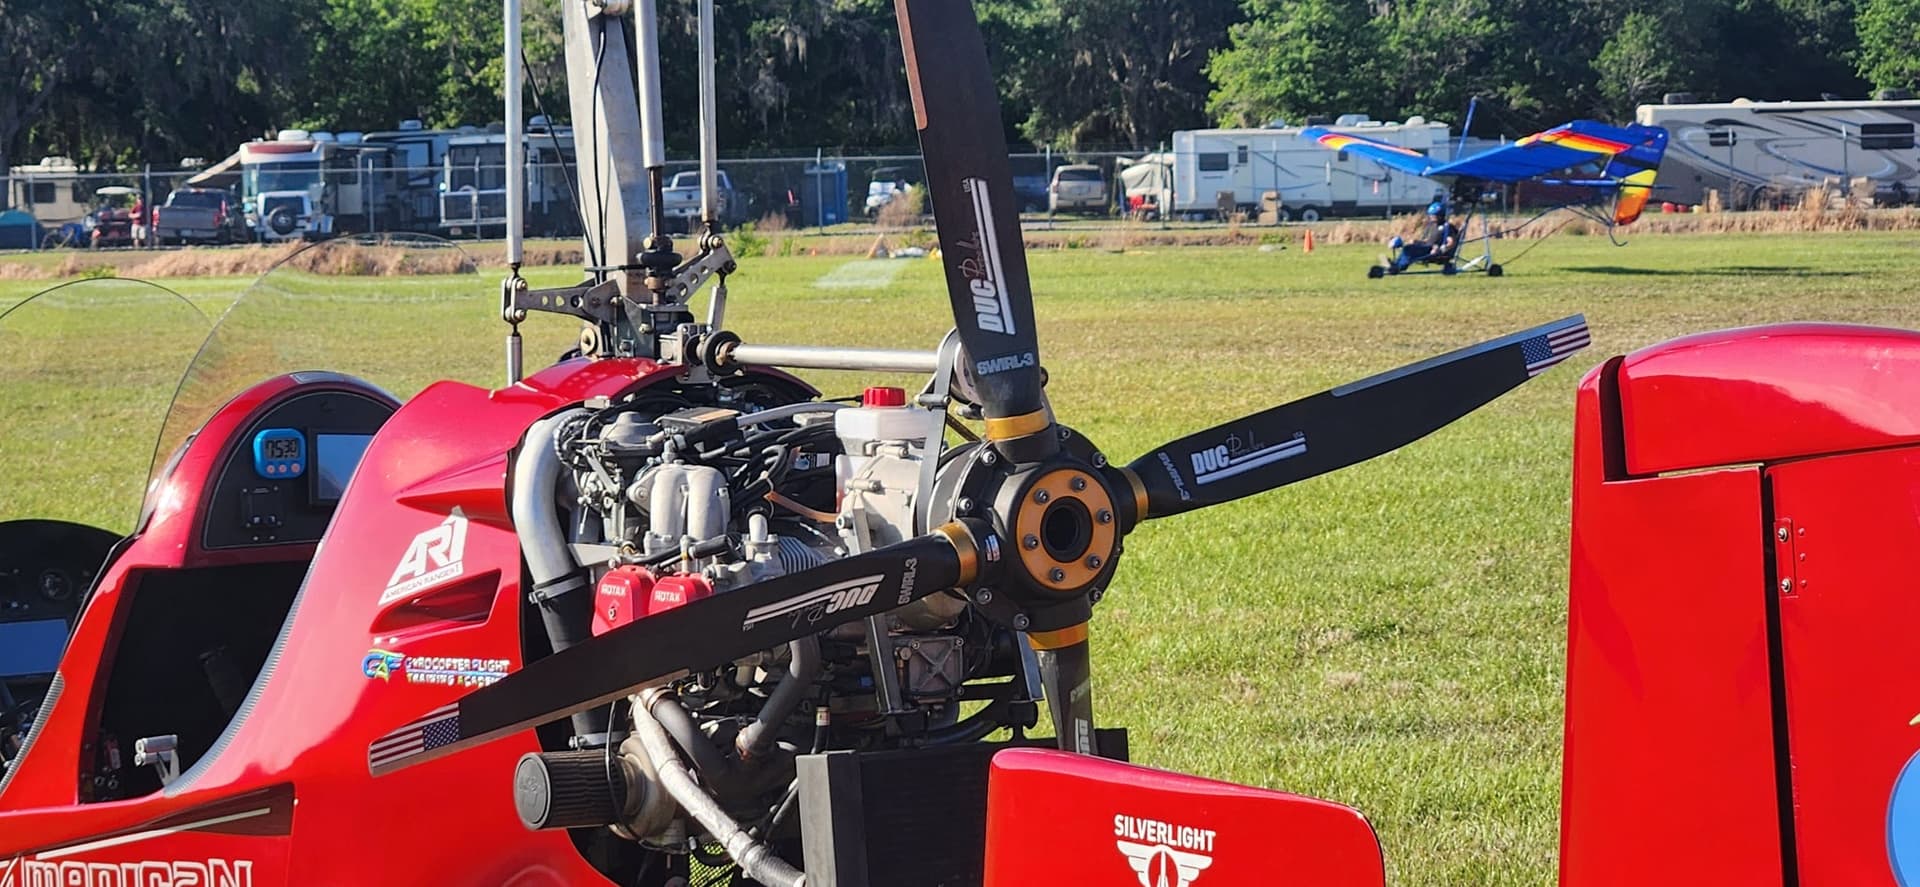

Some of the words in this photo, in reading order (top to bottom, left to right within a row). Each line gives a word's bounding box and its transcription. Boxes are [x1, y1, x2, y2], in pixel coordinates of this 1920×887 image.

[970, 278, 1004, 333] DUC
[977, 352, 1034, 376] SWIRL-3
[1191, 445, 1230, 475] DUC
[1157, 451, 1191, 500] SWIRL-3
[601, 584, 626, 597] ROTAX
[655, 590, 680, 602] ROTAX
[897, 557, 918, 605] SWIRL-3
[825, 583, 880, 614] DUC
[405, 656, 472, 671] GYROCOPTER
[473, 659, 510, 673] FLIGHT
[406, 673, 455, 686] TRAINING
[1114, 814, 1216, 852] SILVERLIGHT
